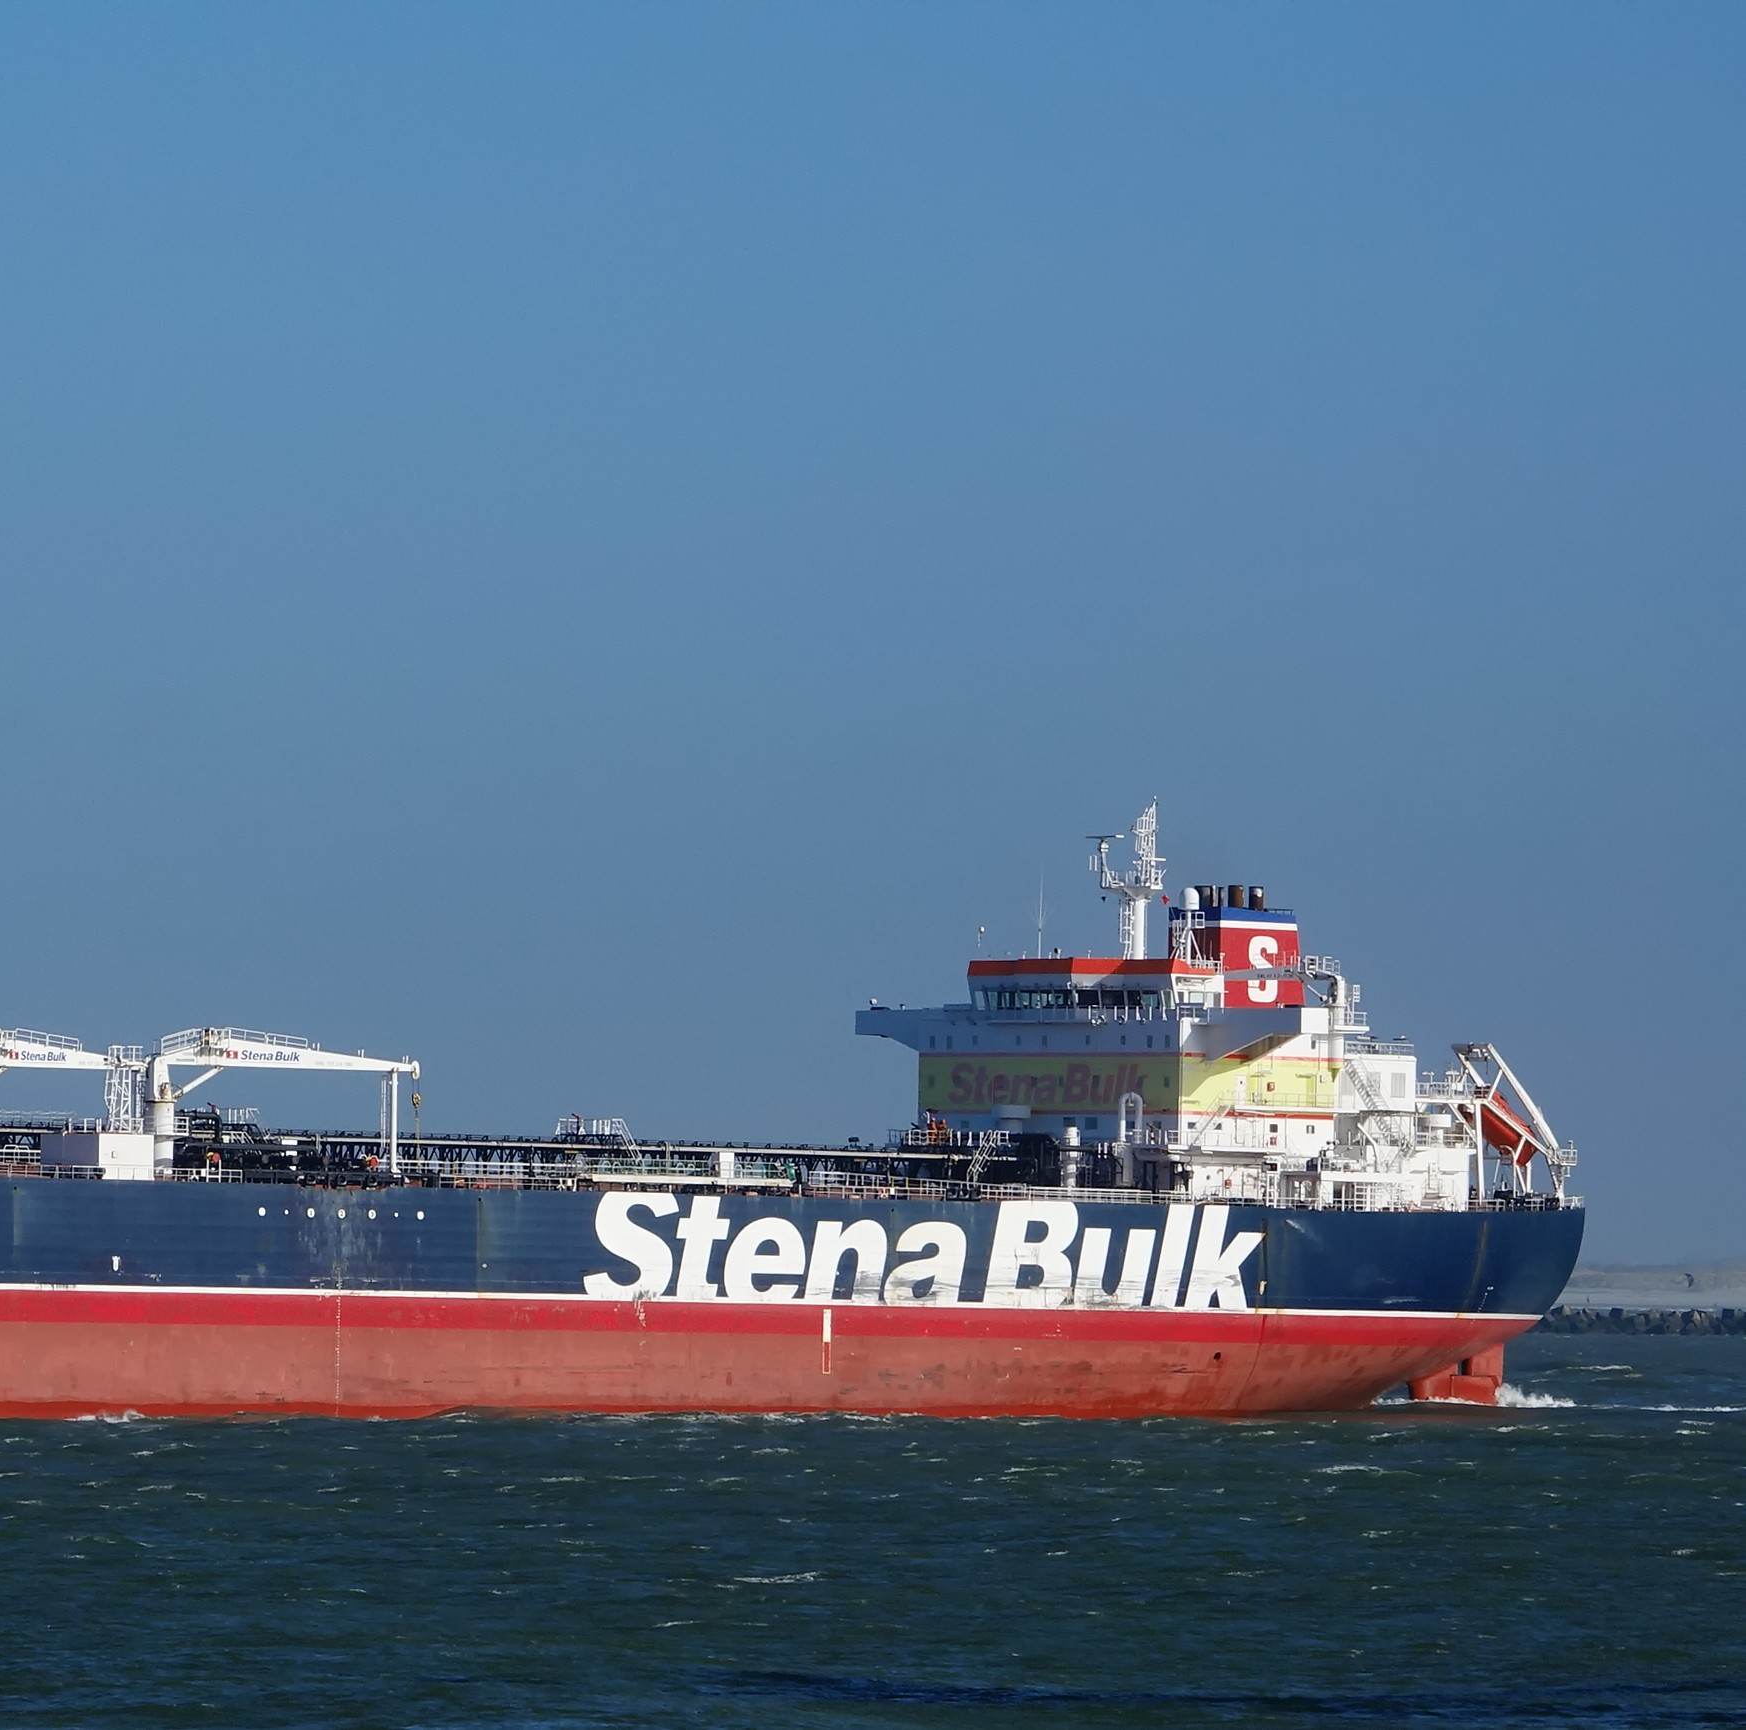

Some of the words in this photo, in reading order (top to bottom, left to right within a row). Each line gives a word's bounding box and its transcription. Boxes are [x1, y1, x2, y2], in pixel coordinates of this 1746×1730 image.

[1247, 935, 1279, 1003] S
[20, 1050, 46, 1062] Stena
[47, 1051, 67, 1062] Bulk
[240, 1049, 273, 1061] Stena
[274, 1051, 300, 1062] Bulk
[948, 1062, 1058, 1105] Stena
[583, 1191, 967, 1304] Stena
[984, 1200, 1266, 1309] Bulk
